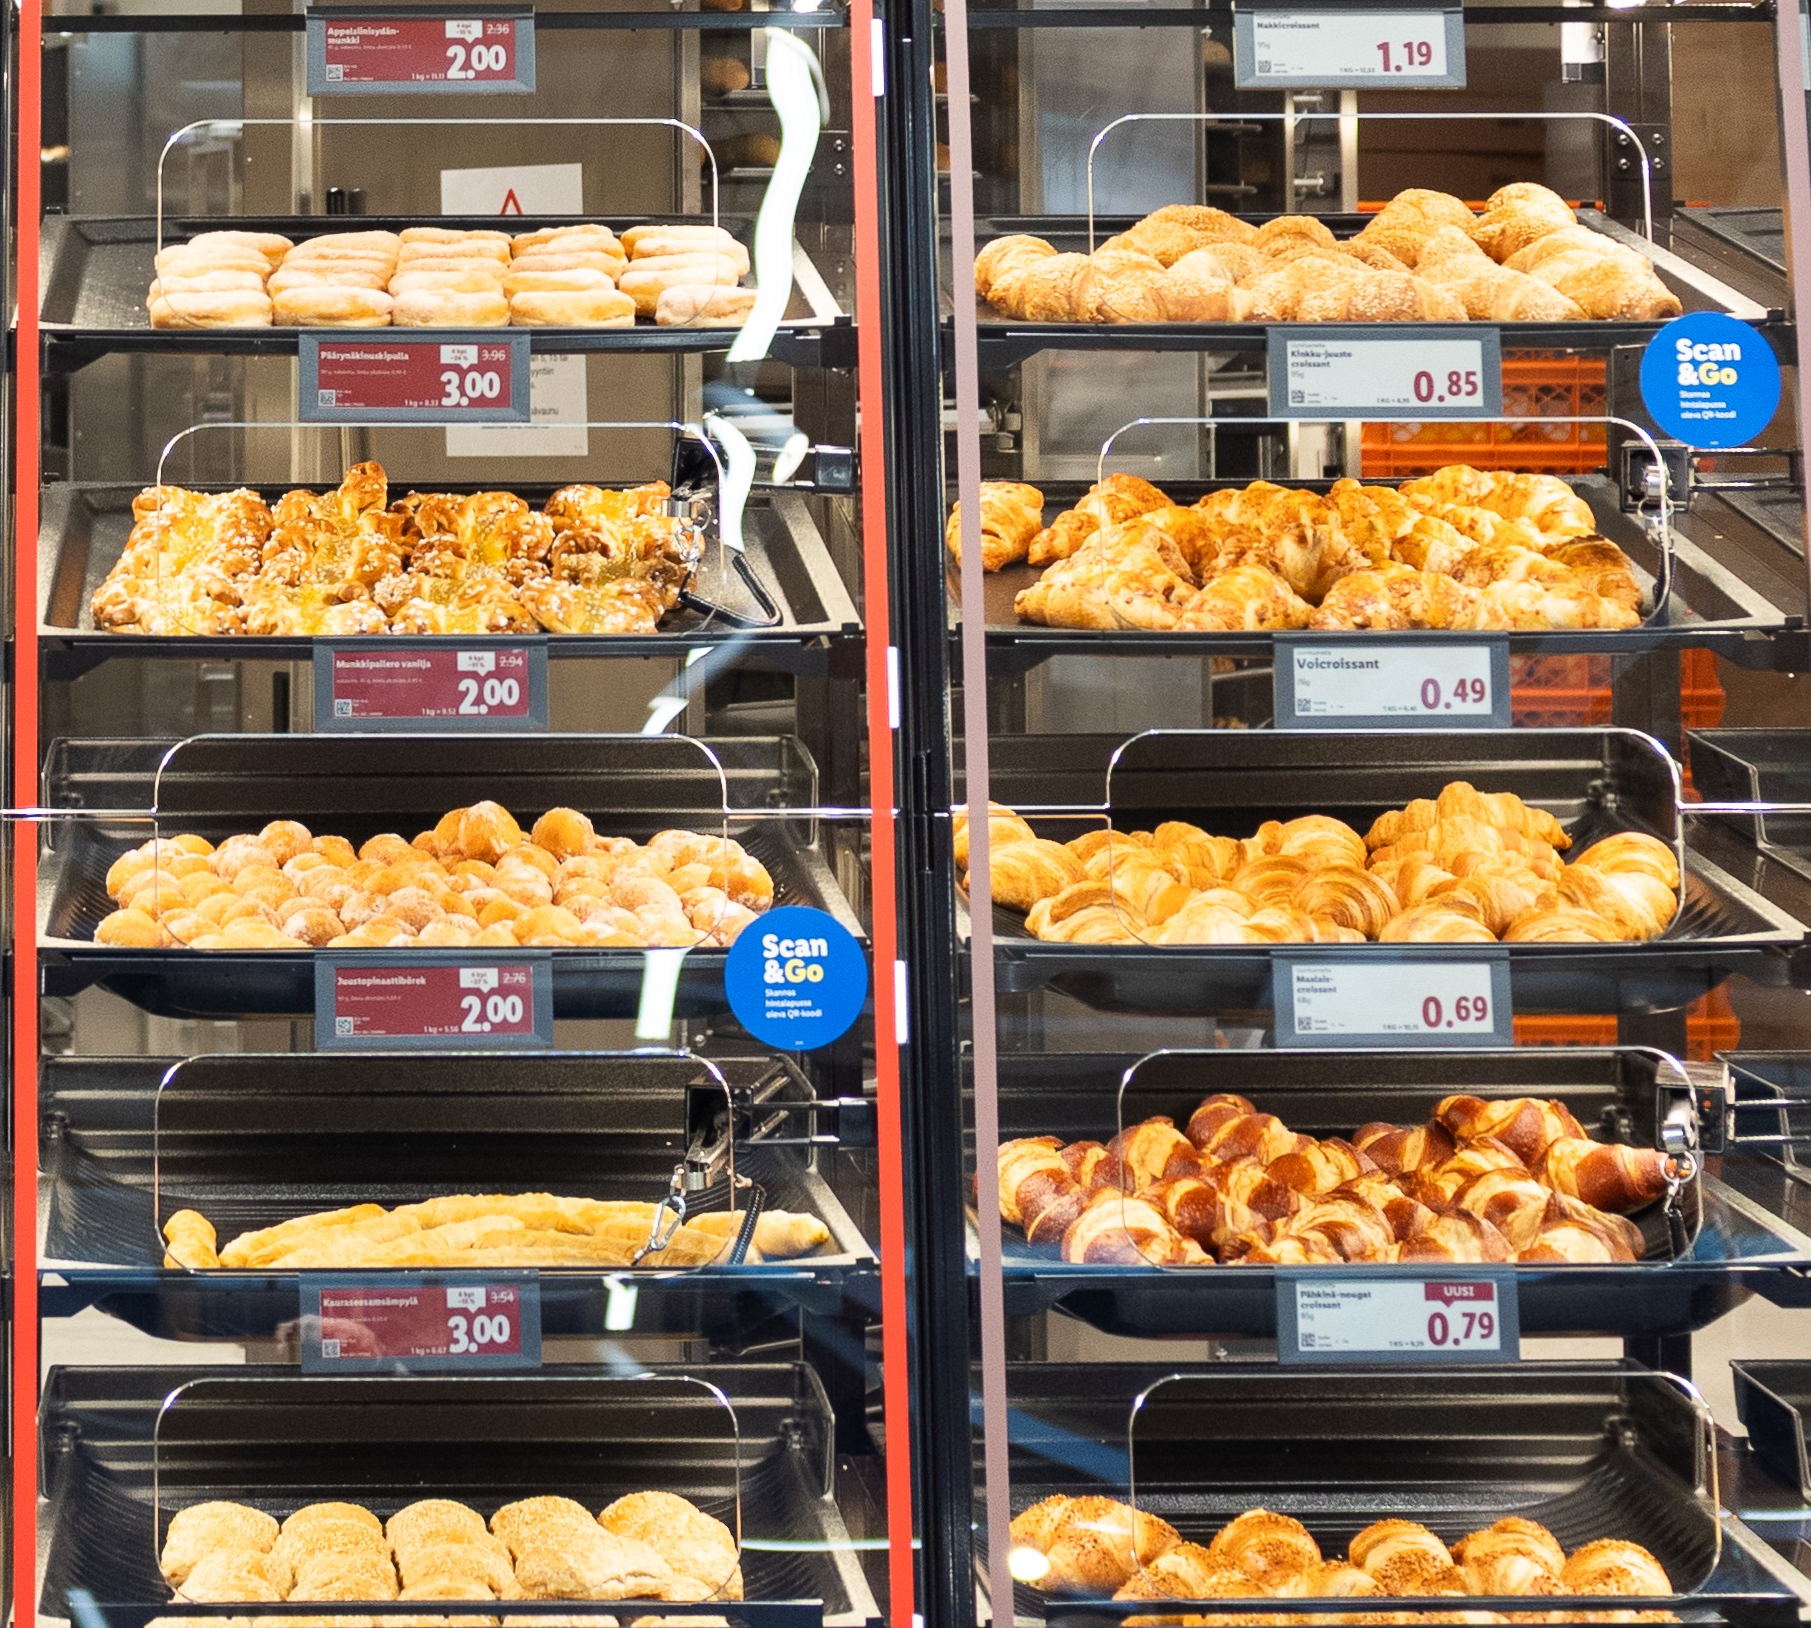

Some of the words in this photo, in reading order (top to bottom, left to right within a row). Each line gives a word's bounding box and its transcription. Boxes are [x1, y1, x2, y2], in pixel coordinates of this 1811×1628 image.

[487, 24, 510, 35] 2.36
[446, 44, 507, 79] 2.00
[1376, 41, 1432, 72] 1.19
[482, 350, 506, 361] 3.96
[1675, 338, 1742, 362] Scan
[1291, 360, 1331, 368] croissant
[1677, 362, 1738, 386] &Go
[440, 371, 501, 407] 3.00
[1413, 370, 1478, 403] 0.85
[499, 656, 523, 667] 2.94
[1297, 658, 1380, 669] Voicroissant
[458, 678, 520, 715] 2.00
[1421, 678, 1486, 709] 0.49
[762, 933, 828, 958] Scan
[503, 972, 526, 984] 2.76
[763, 958, 824, 984] &Go
[1297, 985, 1337, 993] croissant
[460, 995, 523, 1032] 2.00
[1422, 996, 1488, 1028] 0.69
[491, 1291, 515, 1303] 3.54
[1444, 1286, 1475, 1297] UUSI
[1301, 1301, 1341, 1309] croissant
[447, 1315, 510, 1353] 3.00
[1427, 1312, 1494, 1346] 0.79
